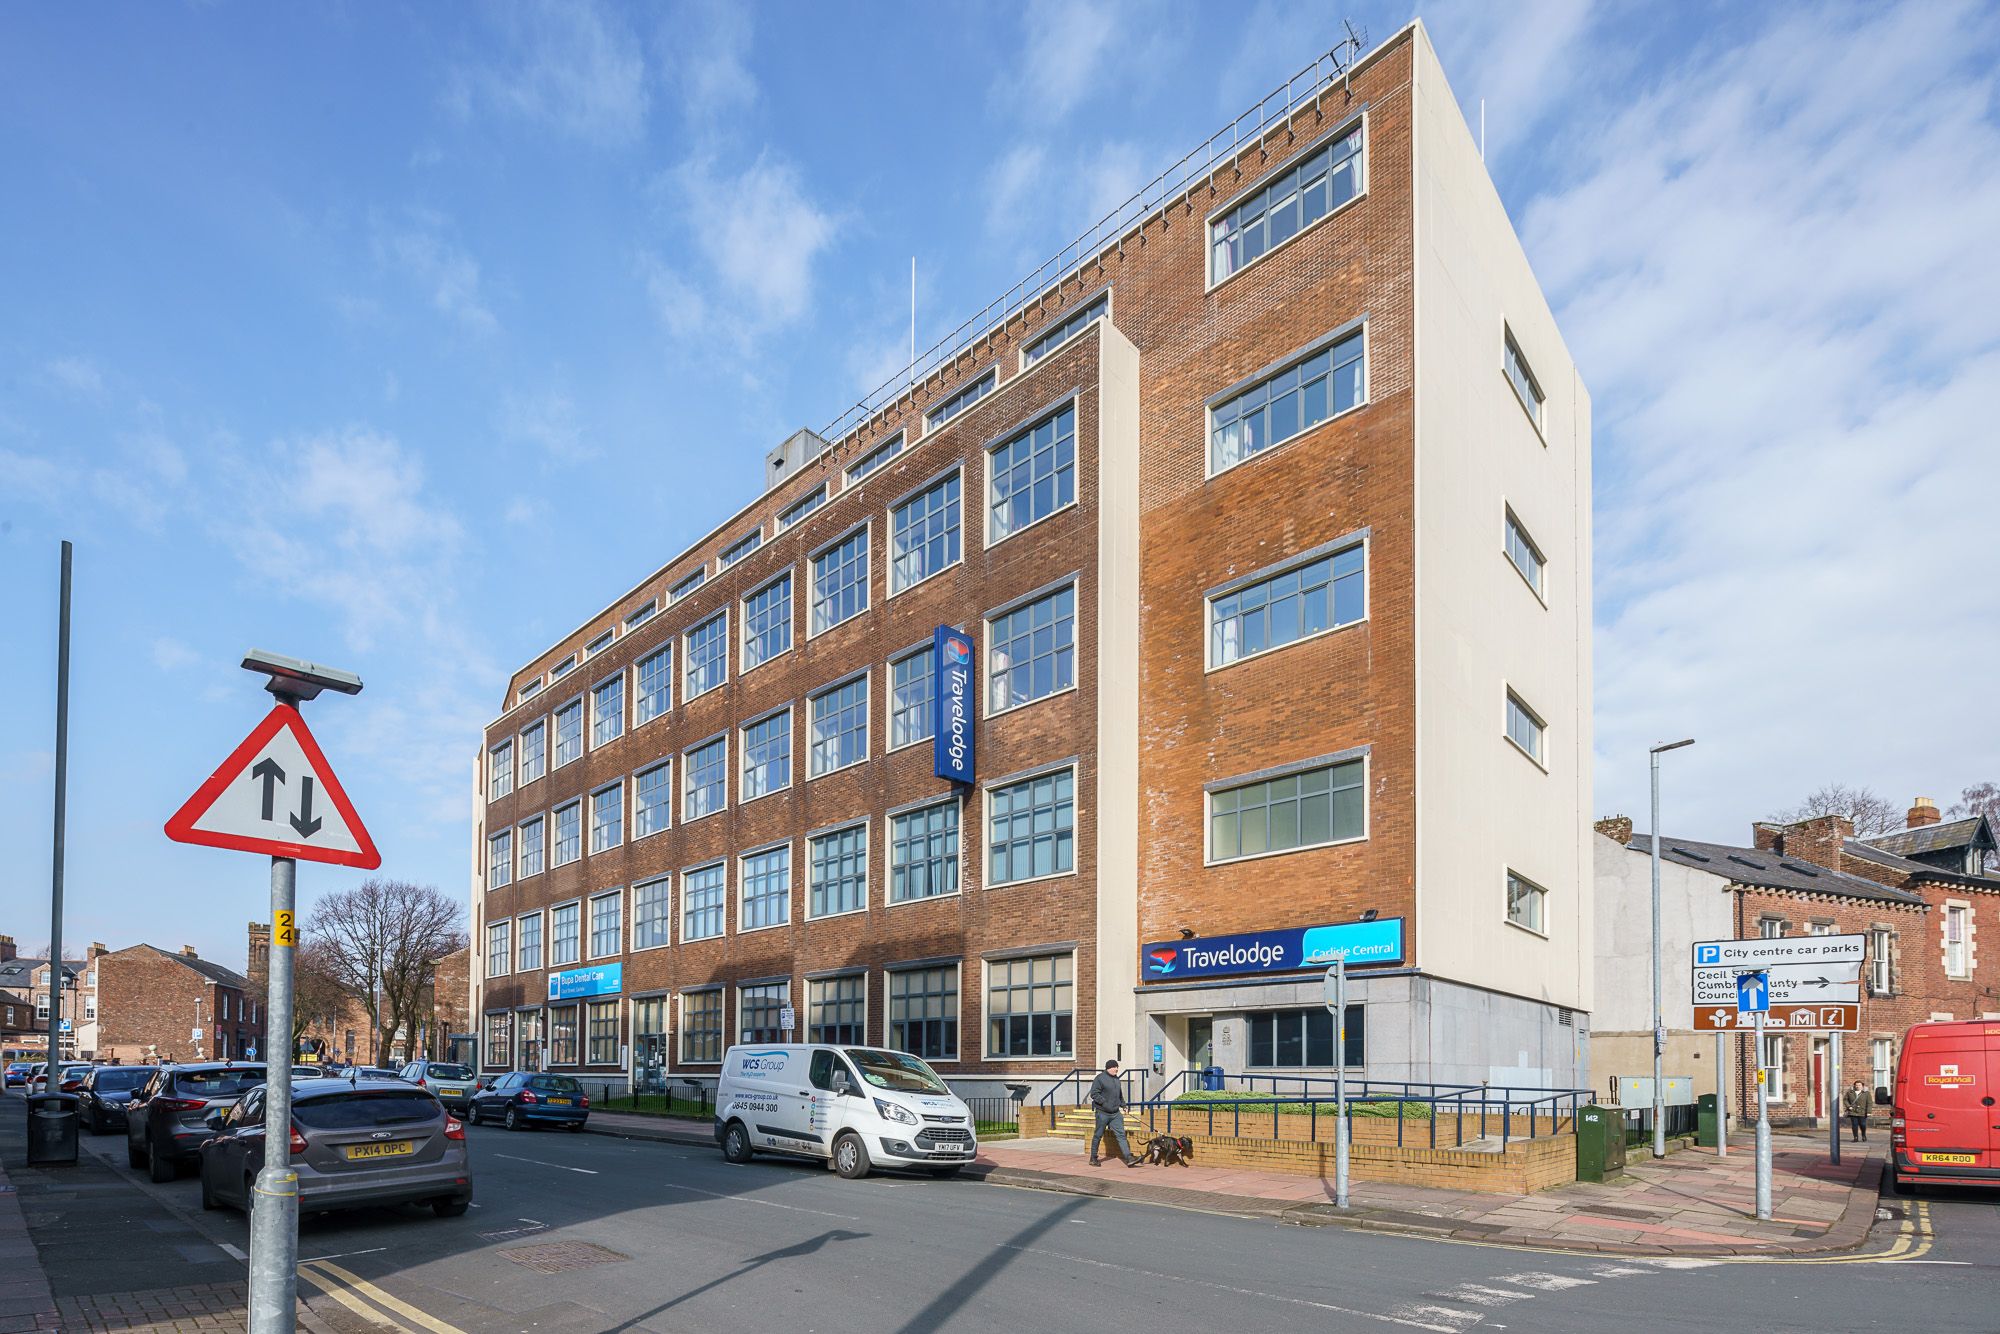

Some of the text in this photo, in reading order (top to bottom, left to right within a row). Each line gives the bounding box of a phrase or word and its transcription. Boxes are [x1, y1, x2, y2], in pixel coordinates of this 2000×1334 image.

[949, 670, 967, 771] Travelodge
[1182, 941, 1284, 969] Travelodge
[1353, 942, 1394, 955] Central
[1724, 949, 1748, 959] City
[1753, 946, 1793, 956] centre
[1797, 947, 1818, 955] car
[1822, 944, 1859, 955] parks
[561, 976, 574, 986] Bupa
[575, 973, 591, 983] Dental
[592, 971, 604, 980] Care
[1697, 970, 1727, 980] Cecil
[1697, 978, 1798, 990] Cumbr unty
[1697, 990, 1738, 1000] Counci
[742, 1059, 784, 1072] WCS Group
[732, 1101, 778, 1112] 0845 0944 300
[1585, 1114, 1599, 1122] 142
[354, 1143, 406, 1157] PX14 OPC
